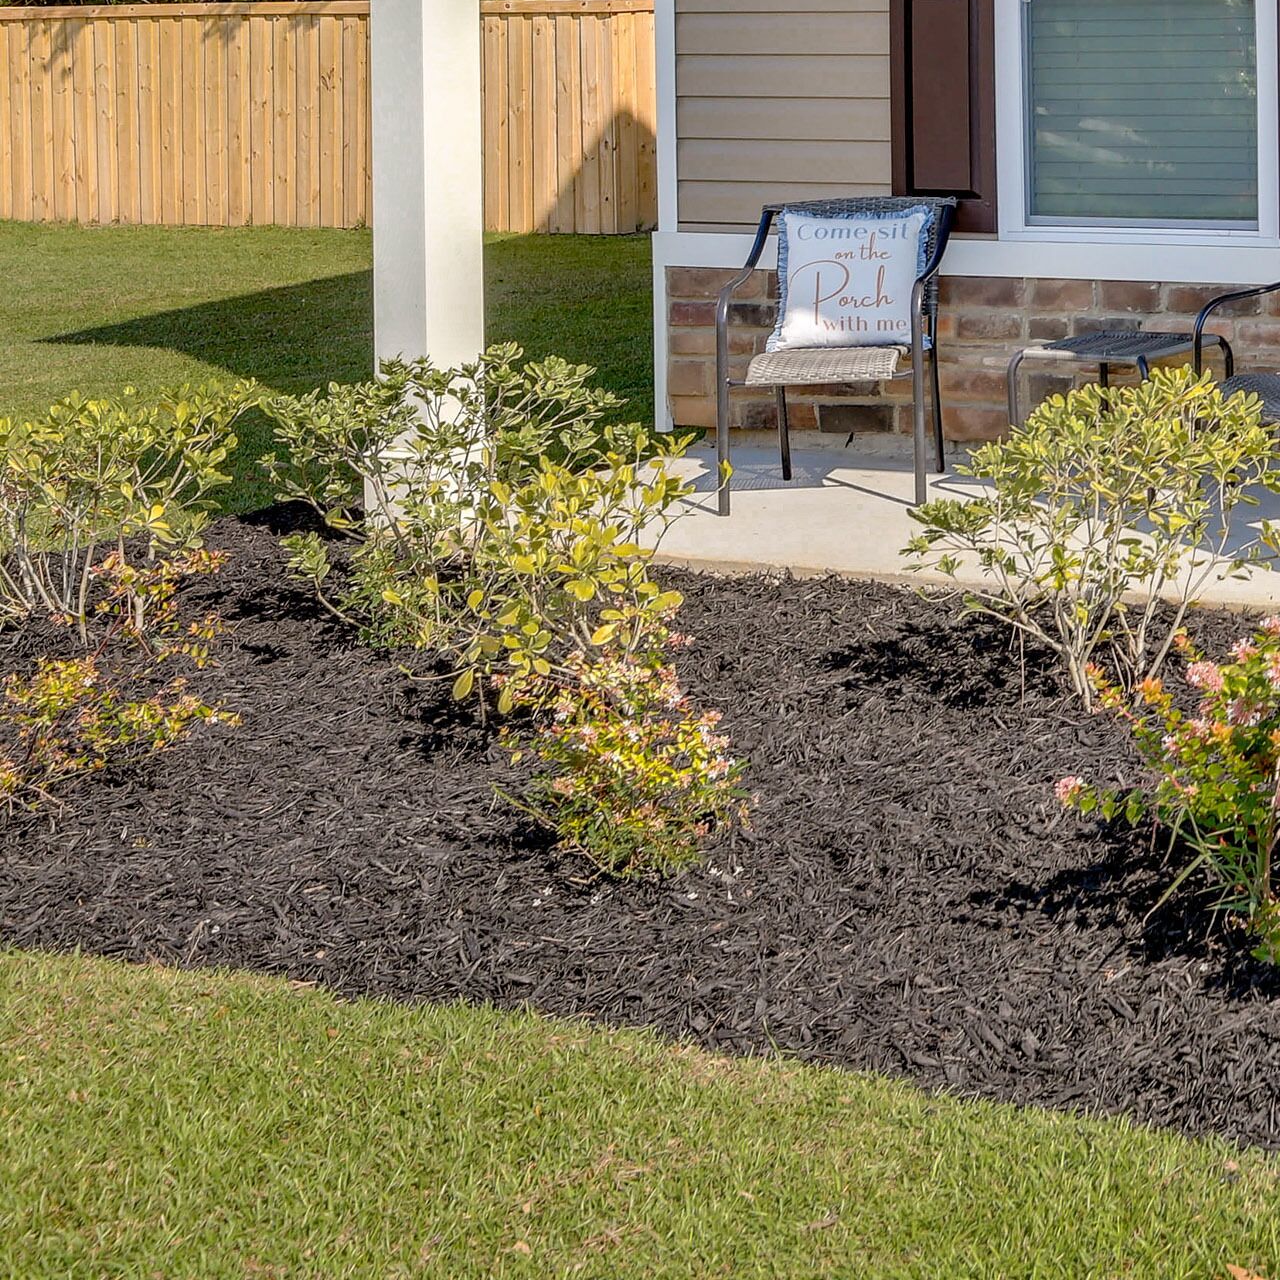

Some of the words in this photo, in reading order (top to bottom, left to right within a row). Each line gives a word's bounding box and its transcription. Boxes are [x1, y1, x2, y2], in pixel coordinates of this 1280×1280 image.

[797, 223, 868, 241] Come
[878, 222, 909, 240] sit
[834, 250, 856, 261] on
[859, 232, 893, 261] the
[788, 260, 894, 326] Porch
[823, 316, 868, 332] with
[876, 319, 907, 332] me
